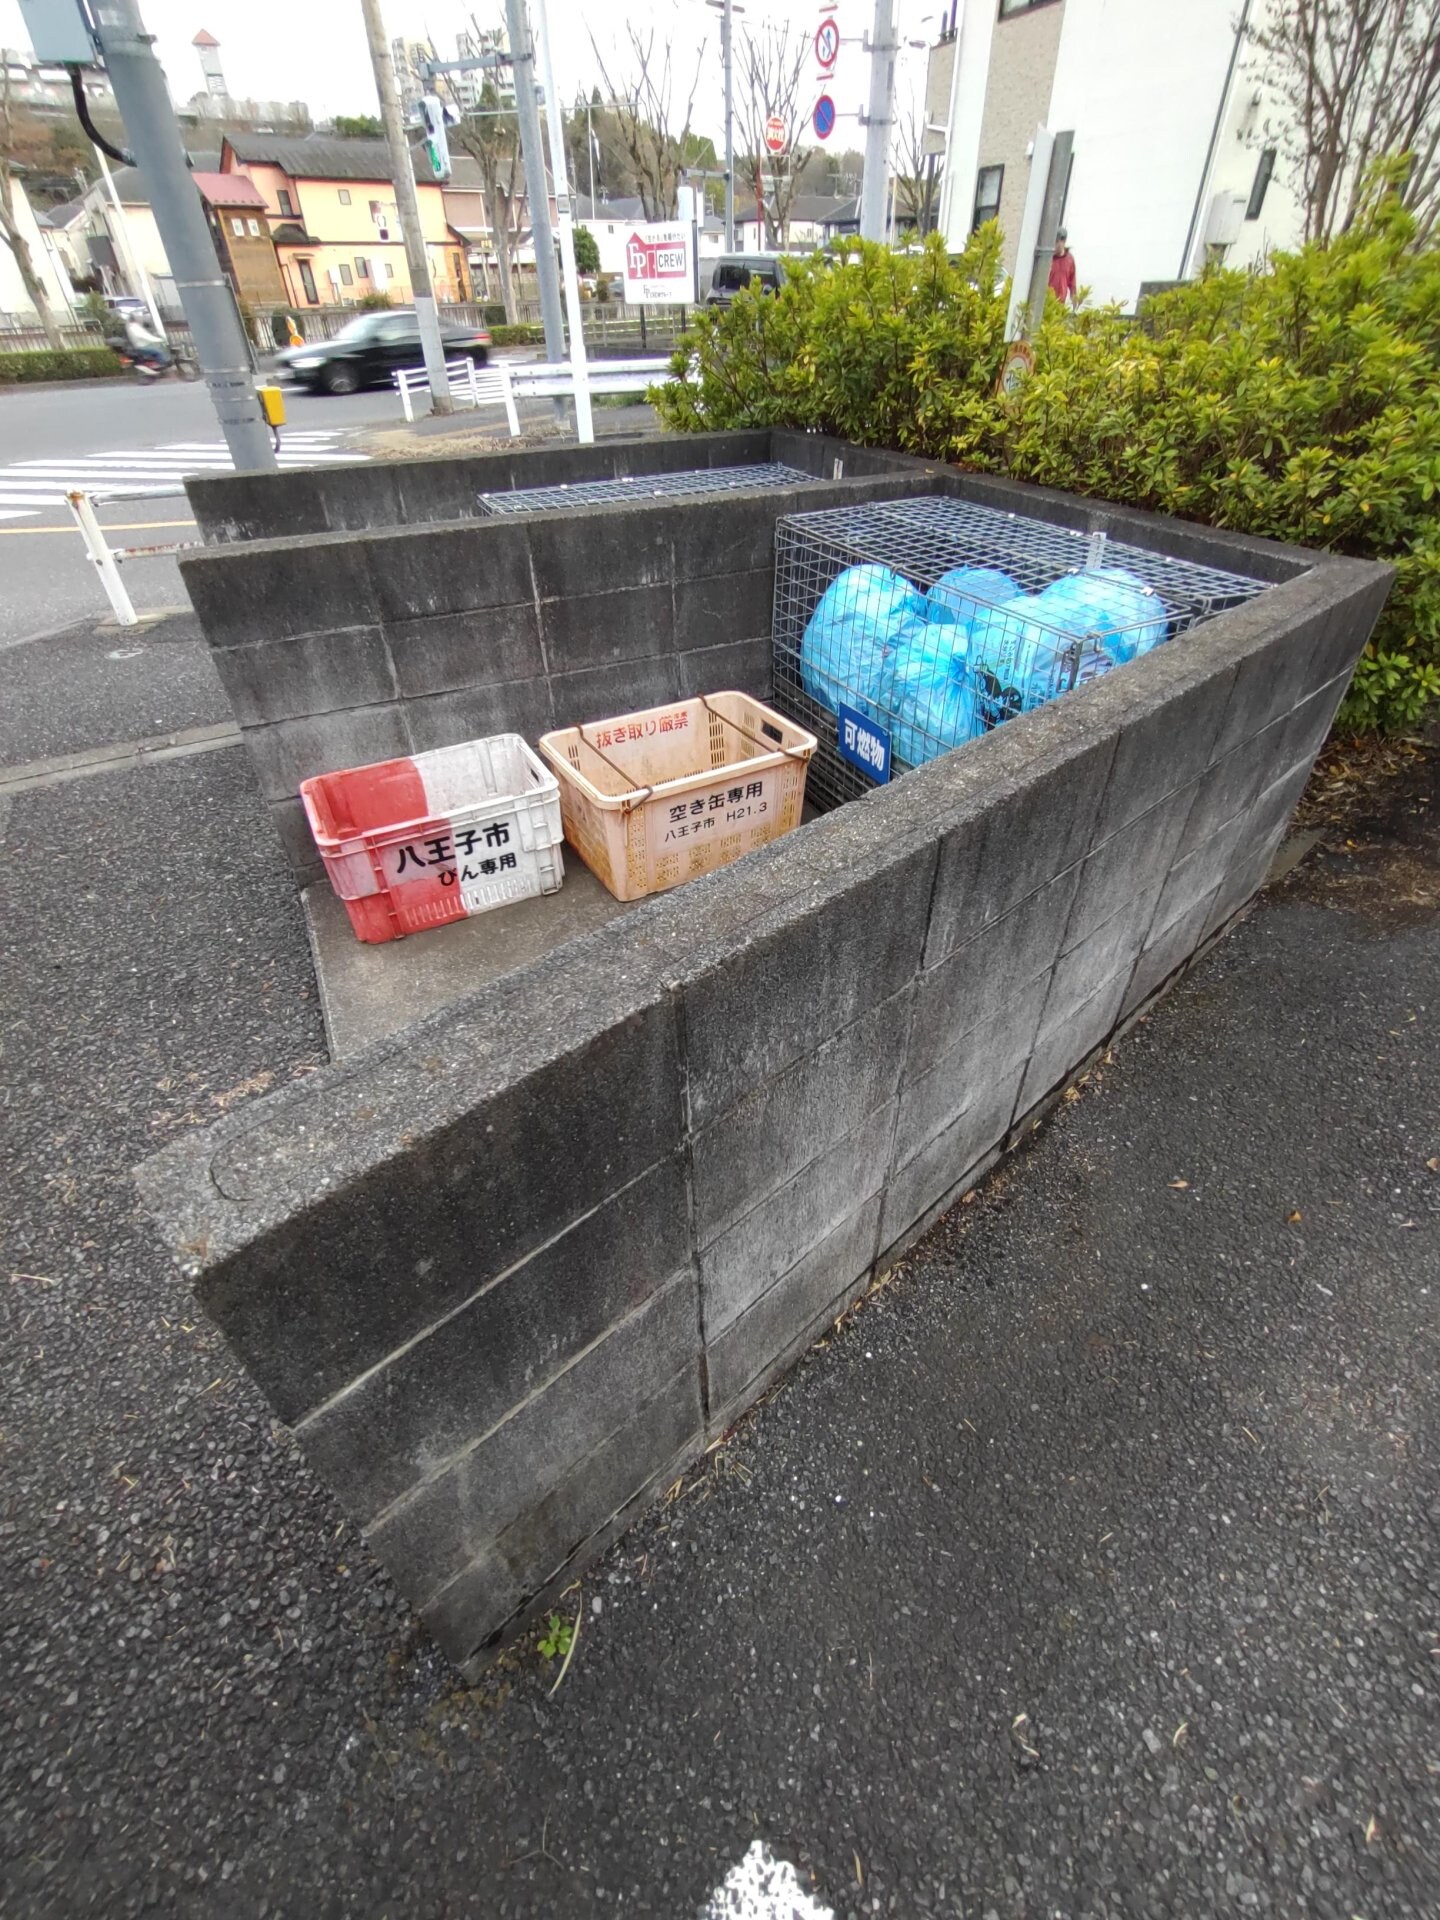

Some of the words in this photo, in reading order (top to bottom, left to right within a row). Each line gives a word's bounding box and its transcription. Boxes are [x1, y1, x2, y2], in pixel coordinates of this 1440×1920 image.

[658, 253, 683, 268] CREW
[596, 711, 689, 749] 抜き取り厳禁
[844, 718, 885, 771] 可燃物
[665, 816, 715, 842] 八王子市
[726, 802, 767, 822] H21.3
[669, 781, 763, 823] 空き缶専用
[397, 822, 510, 873] 八王子市
[438, 852, 517, 886] びん専用
